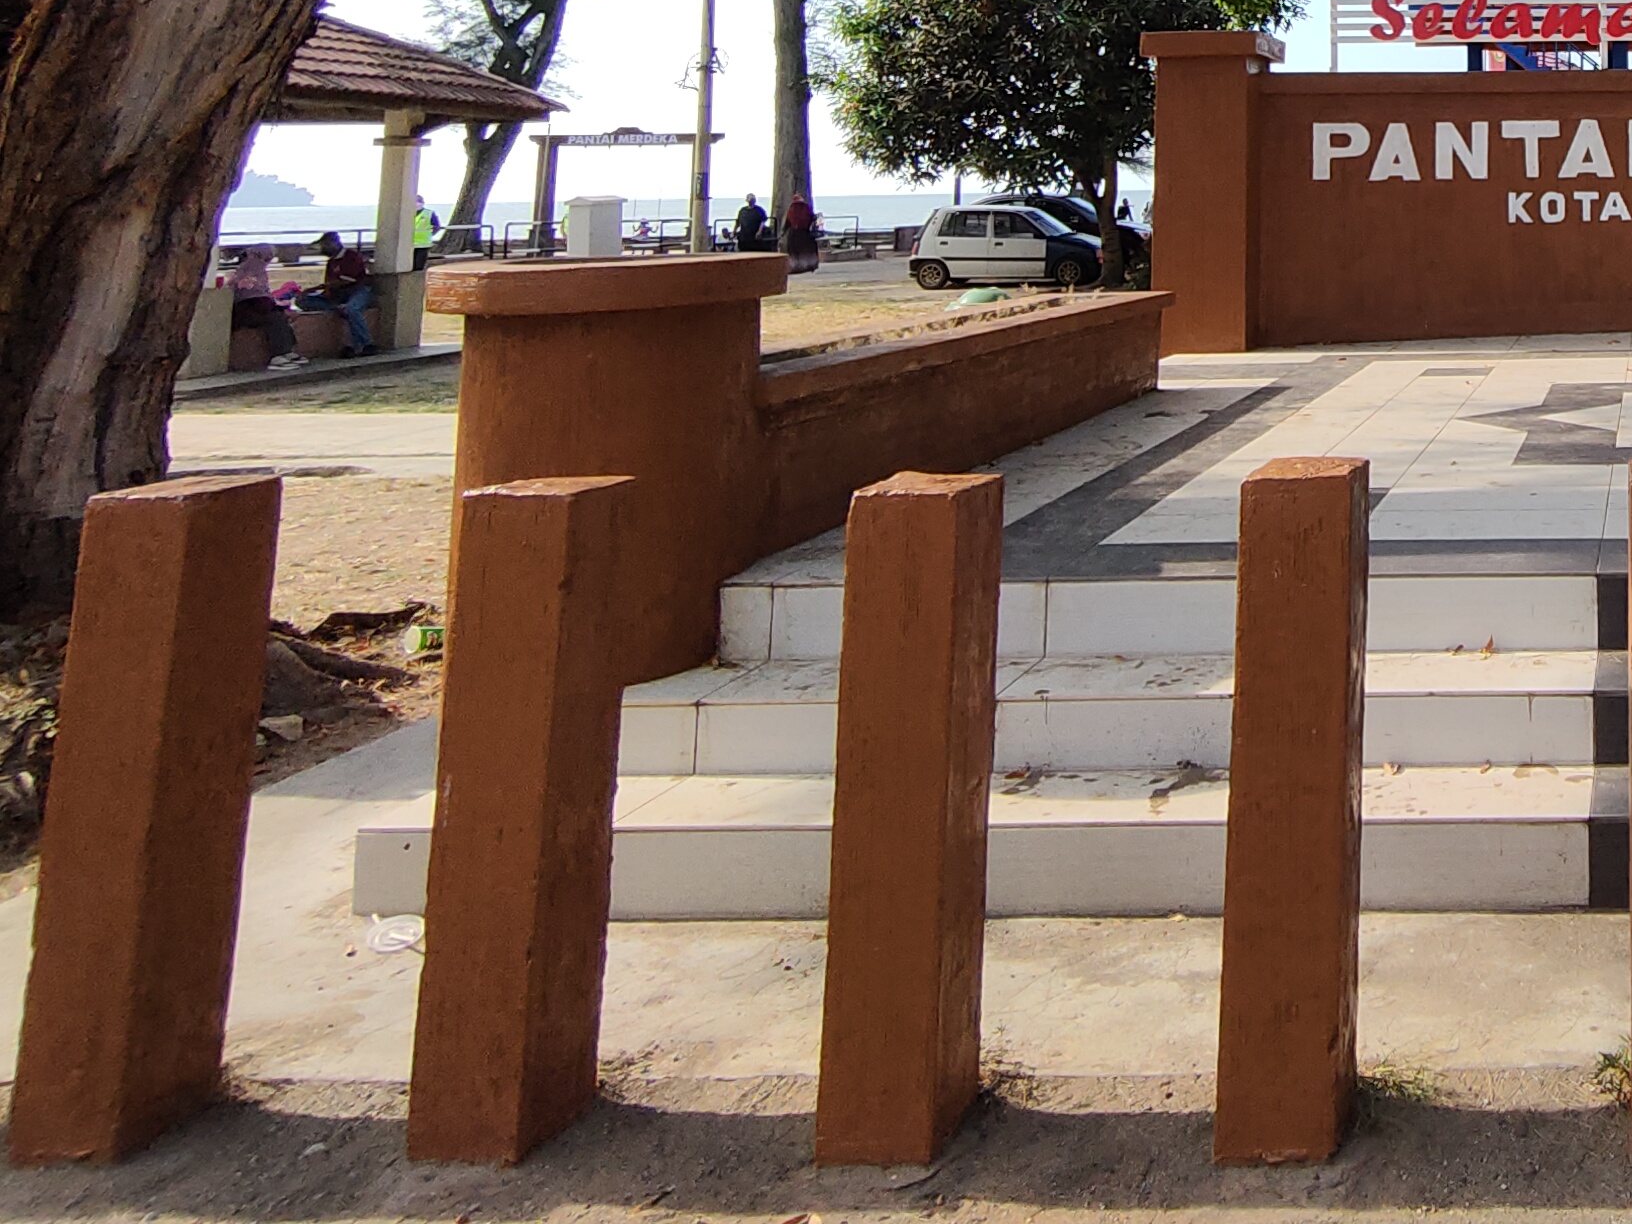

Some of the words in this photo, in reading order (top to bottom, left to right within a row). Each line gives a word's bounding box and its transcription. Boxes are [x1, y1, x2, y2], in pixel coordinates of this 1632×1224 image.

[567, 135, 615, 145] PANTAI
[618, 134, 678, 144] MERDEKA
[1507, 191, 1632, 225] KOTA
